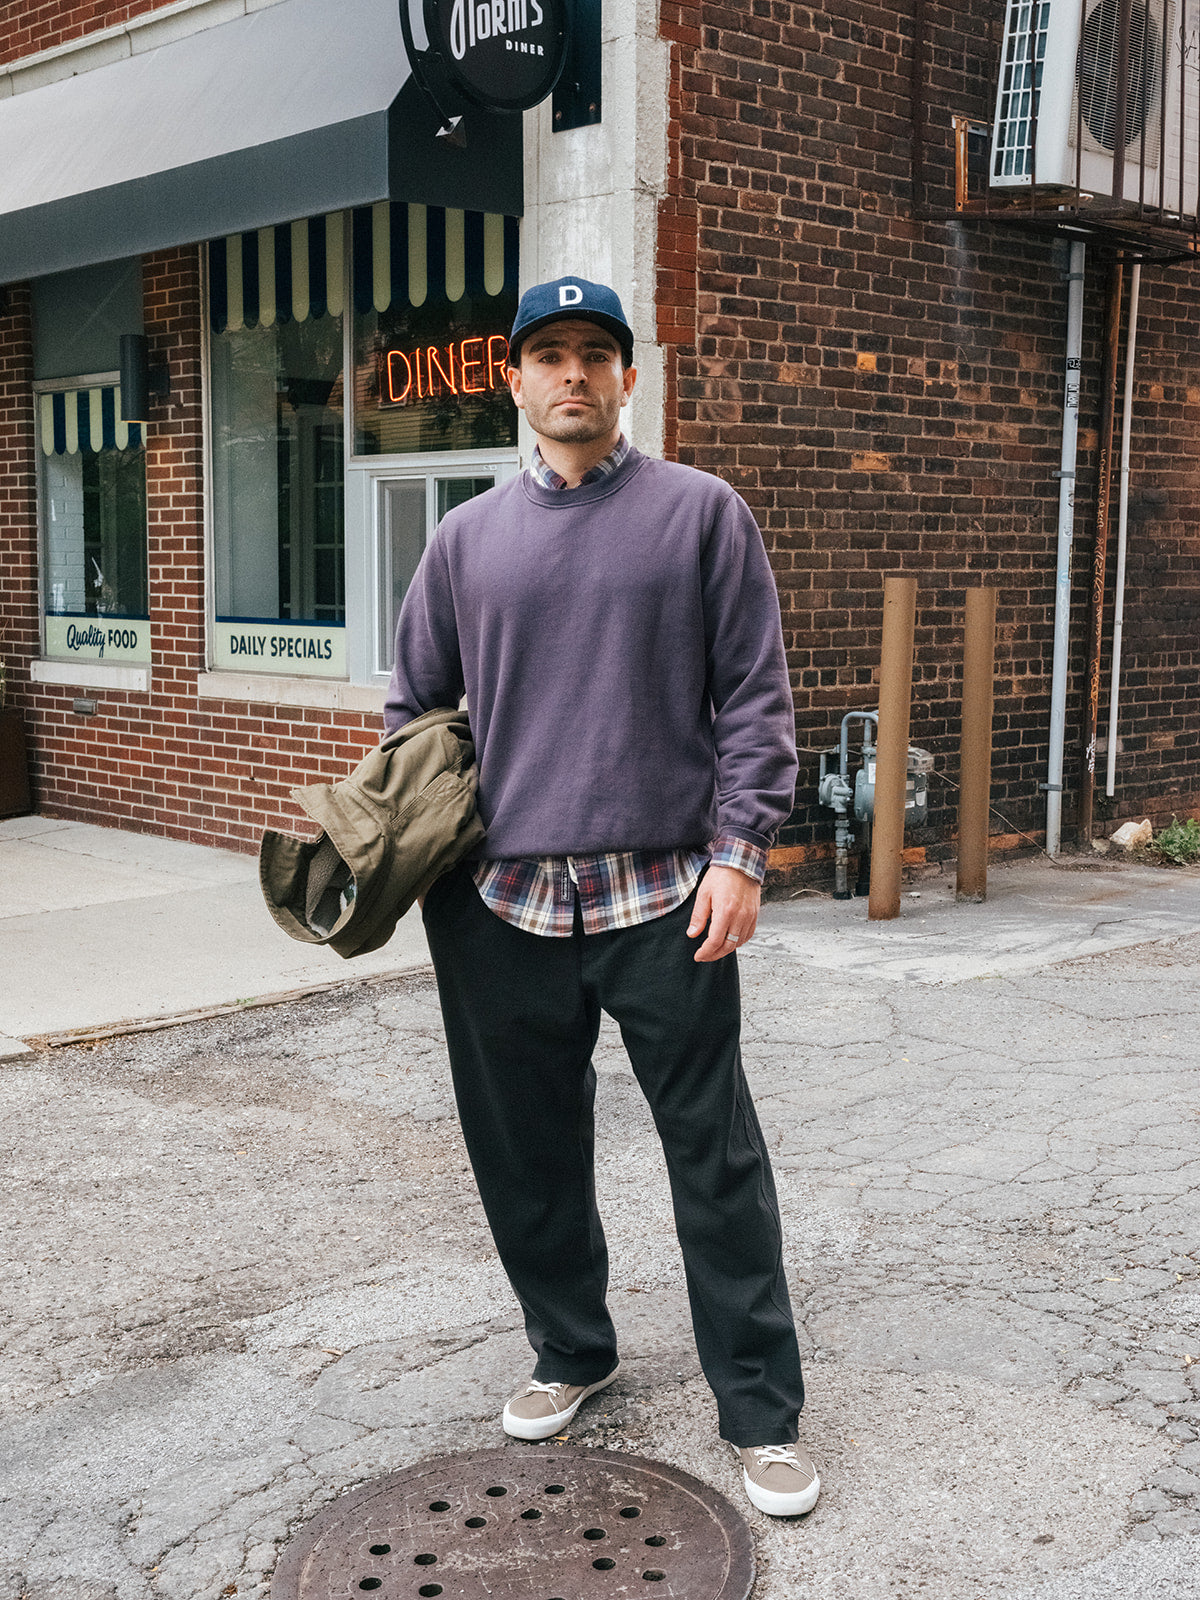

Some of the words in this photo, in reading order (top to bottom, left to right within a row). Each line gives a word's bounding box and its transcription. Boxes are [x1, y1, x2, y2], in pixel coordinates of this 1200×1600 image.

[506, 40, 544, 56] DINER
[559, 286, 583, 306] D
[387, 335, 510, 402] DINER
[67, 624, 105, 657] Quality
[109, 629, 137, 649] FOOD
[231, 635, 266, 655] DAILY
[271, 637, 332, 660] SPECIALS
